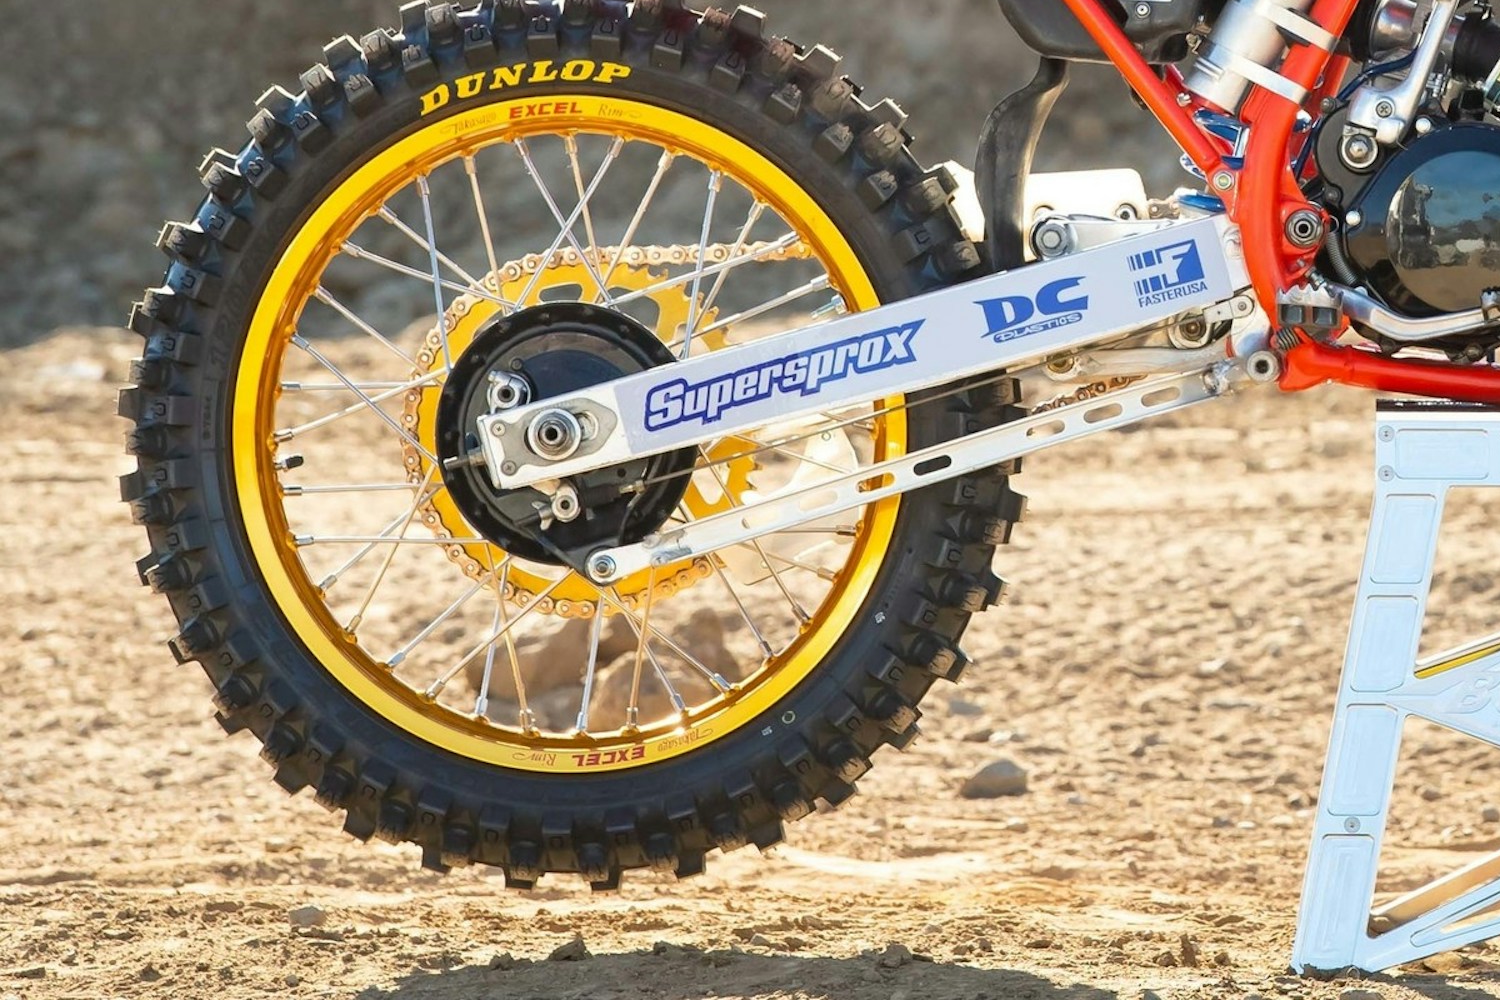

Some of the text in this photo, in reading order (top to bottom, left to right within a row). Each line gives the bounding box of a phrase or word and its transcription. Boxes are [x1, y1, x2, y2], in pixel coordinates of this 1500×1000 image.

[420, 60, 632, 116] DUNLOP
[509, 102, 582, 120] EXCEL
[973, 276, 1088, 338] DC
[1138, 281, 1208, 308] FASTERUSA
[646, 321, 922, 430] Supersprox
[572, 745, 646, 767] EXCEL
